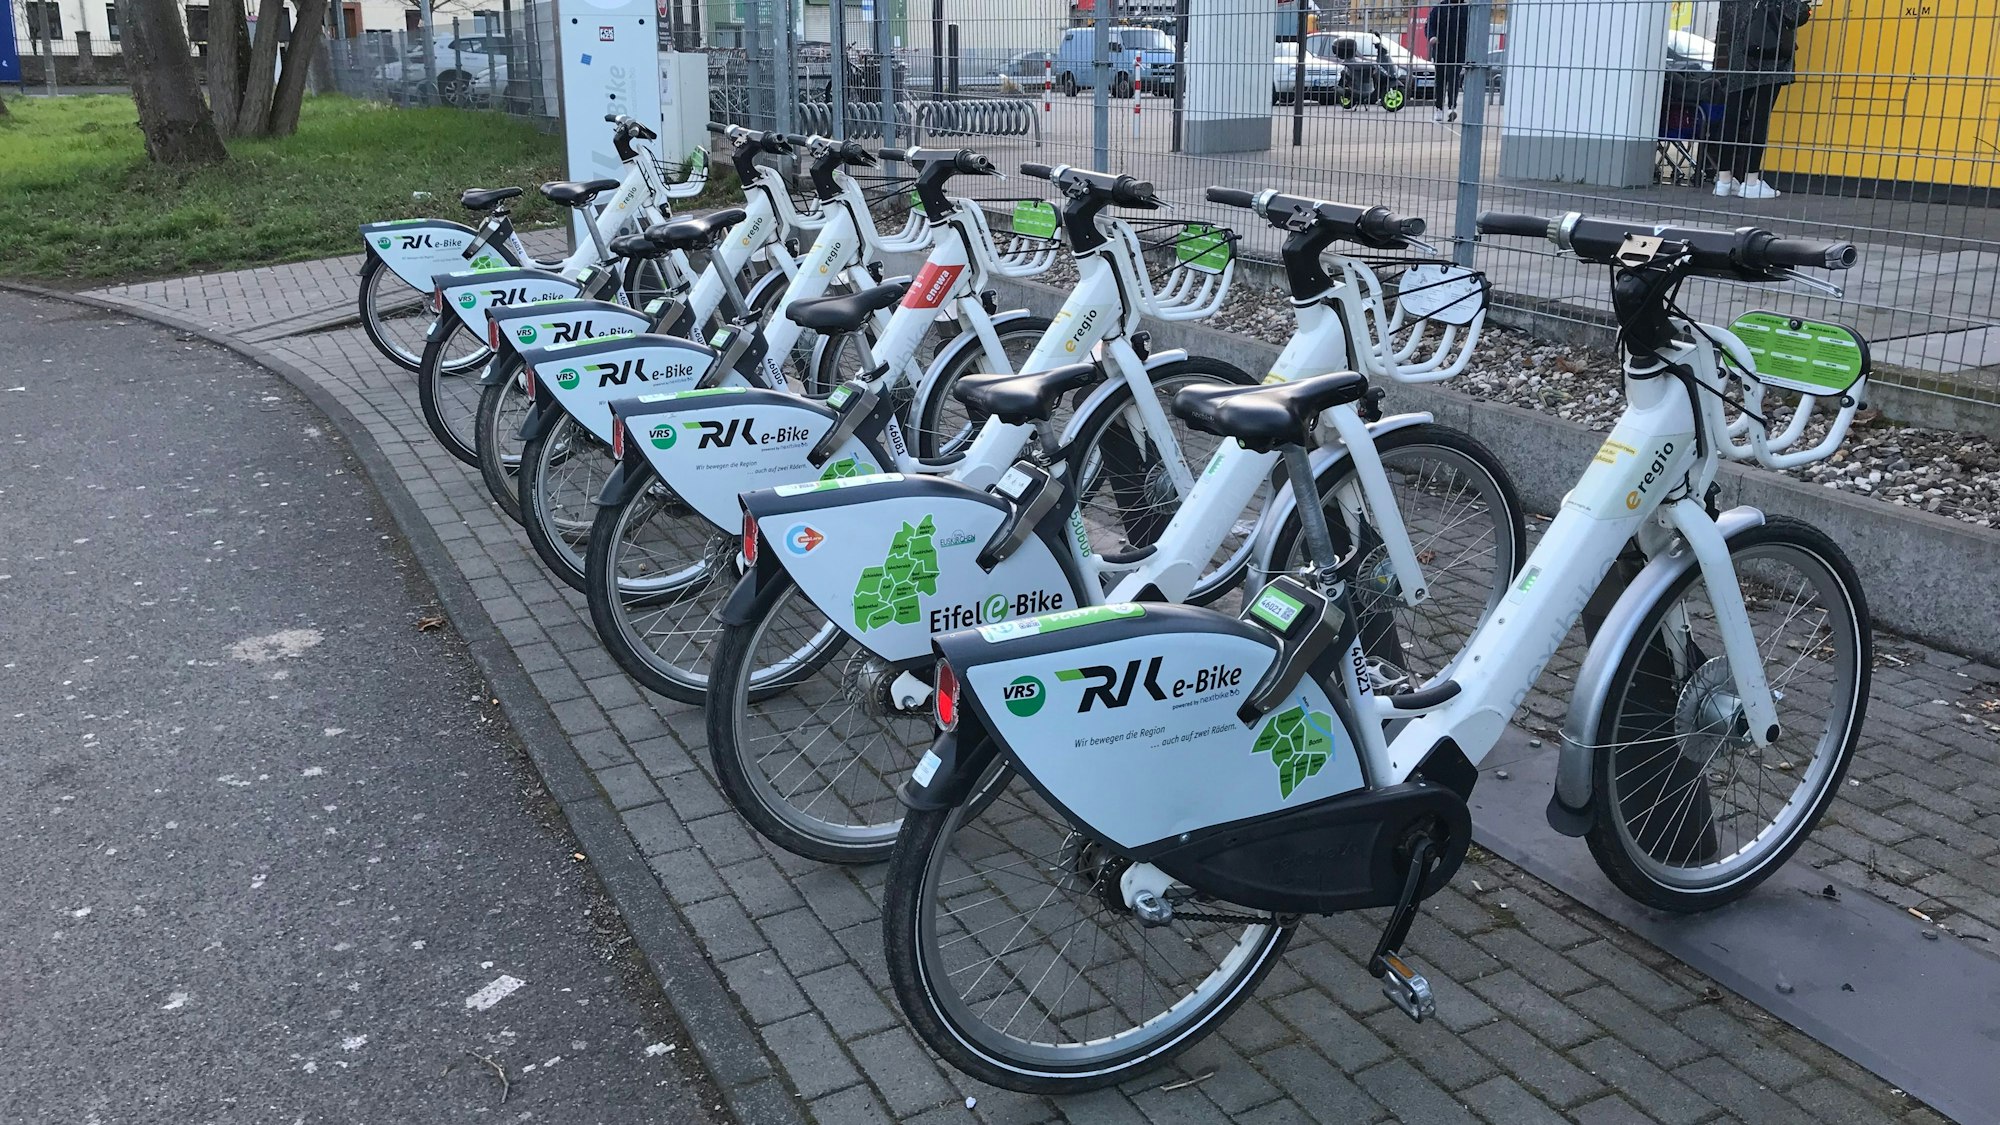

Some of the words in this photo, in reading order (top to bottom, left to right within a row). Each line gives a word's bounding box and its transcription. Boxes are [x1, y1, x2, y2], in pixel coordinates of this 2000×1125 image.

[1905, 7, 1918, 16] XL
[1921, 6, 1931, 16] M
[434, 238, 462, 248] e-Bike
[925, 269, 950, 302] enewa
[516, 329, 532, 337] VRS
[556, 372, 574, 381] VRS
[652, 363, 693, 381] e-Bike
[767, 358, 783, 385] 46006
[649, 429, 670, 439] VRS
[761, 426, 809, 445] e-Bike
[889, 423, 905, 456] 46081
[706, 463, 729, 471] bewegen
[740, 460, 758, 469] Region
[768, 466, 777, 474] auf
[940, 533, 976, 547] EUSKIRCHEN
[1069, 510, 1091, 558] 530606
[1261, 599, 1283, 615] 46021
[930, 601, 983, 634] Eifel
[1350, 646, 1371, 696] 46021
[1172, 663, 1243, 698] e-Bike
[1003, 683, 1036, 700] VRS
[1172, 701, 1193, 711] powered
[1199, 690, 1230, 704] nextbike
[1074, 738, 1089, 748] Wir
[1090, 734, 1125, 746] bewegen
[1126, 730, 1138, 740] die
[1139, 725, 1166, 739] Region
[1161, 734, 1180, 747] auch
[1180, 730, 1194, 743] auf
[1194, 728, 1211, 740] zwei
